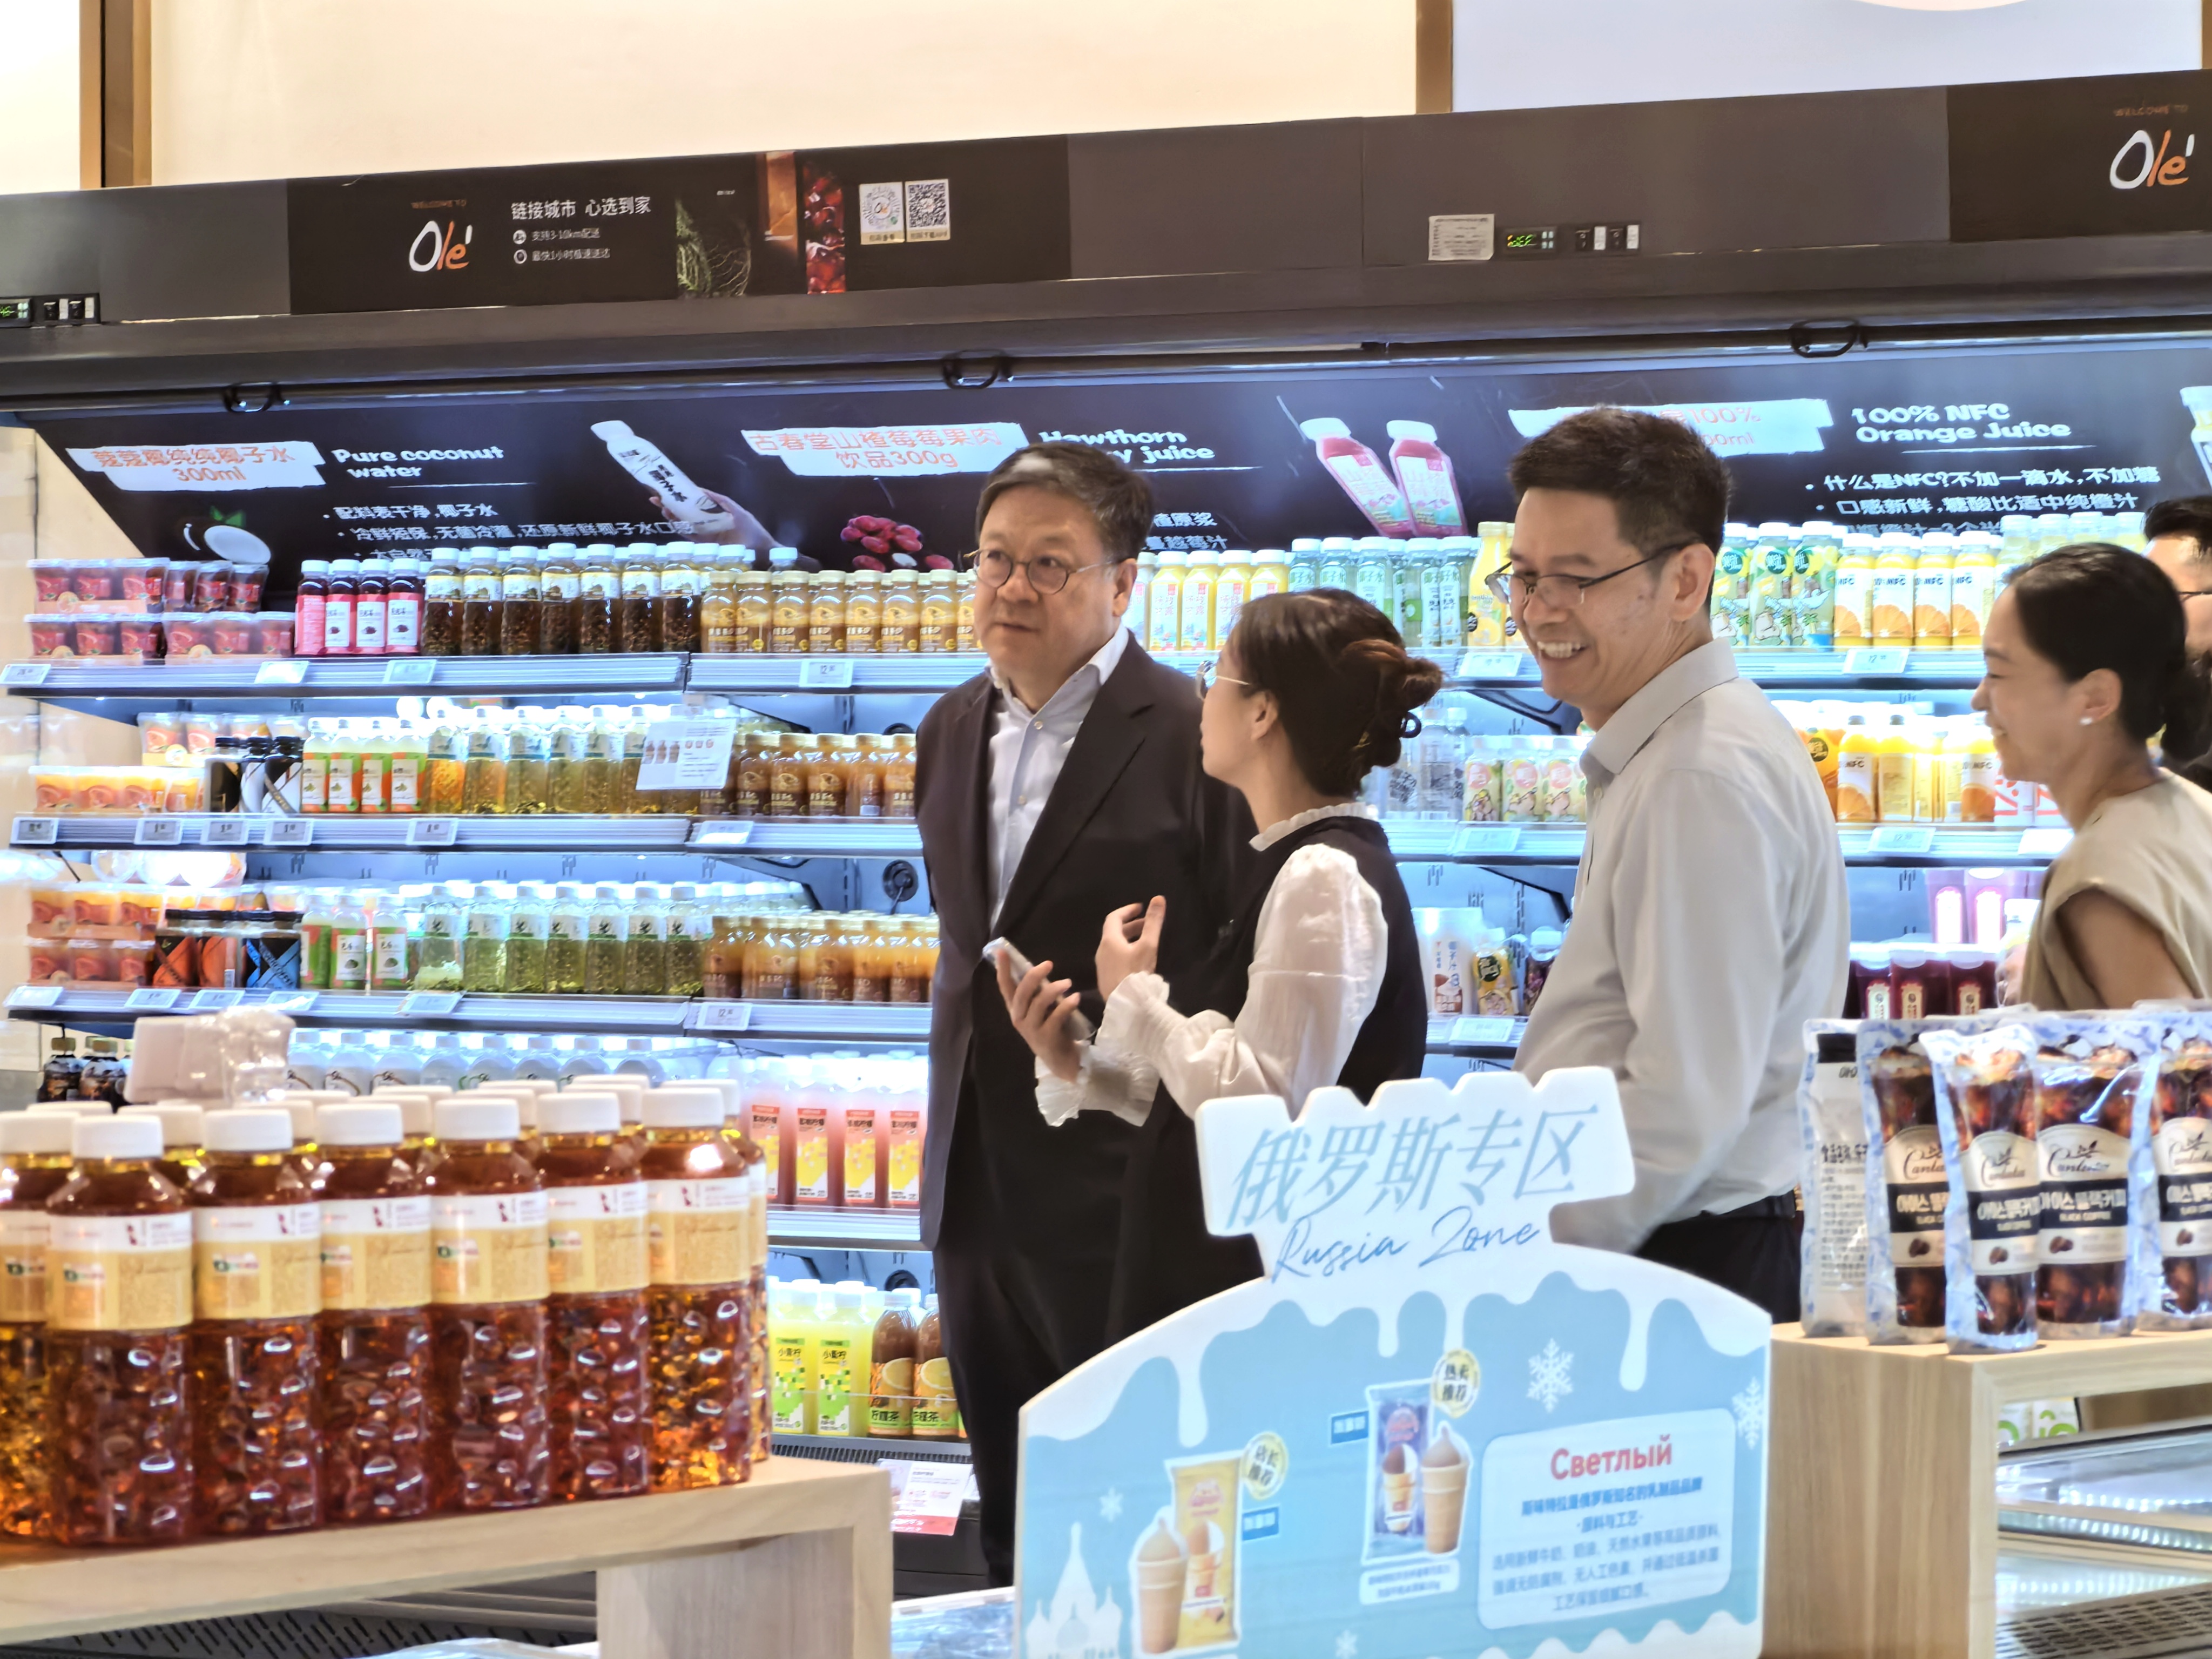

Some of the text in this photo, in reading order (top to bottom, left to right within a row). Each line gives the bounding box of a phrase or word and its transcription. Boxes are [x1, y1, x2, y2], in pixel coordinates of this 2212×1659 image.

[511, 196, 652, 220] 链接城市 心选到家
[1851, 403, 2011, 424] 100% NFC
[1856, 421, 2072, 443] Orange Juice
[331, 446, 504, 463] Pure coconut
[835, 450, 959, 469] 饮品300g
[1139, 445, 1216, 464] juice
[172, 466, 247, 481] 300ml
[347, 464, 423, 479] water
[1226, 1103, 1599, 1230] 俄罗斯专区
[1271, 1205, 1540, 1285] Russia Zone
[1550, 1433, 1673, 1480] Светлый
